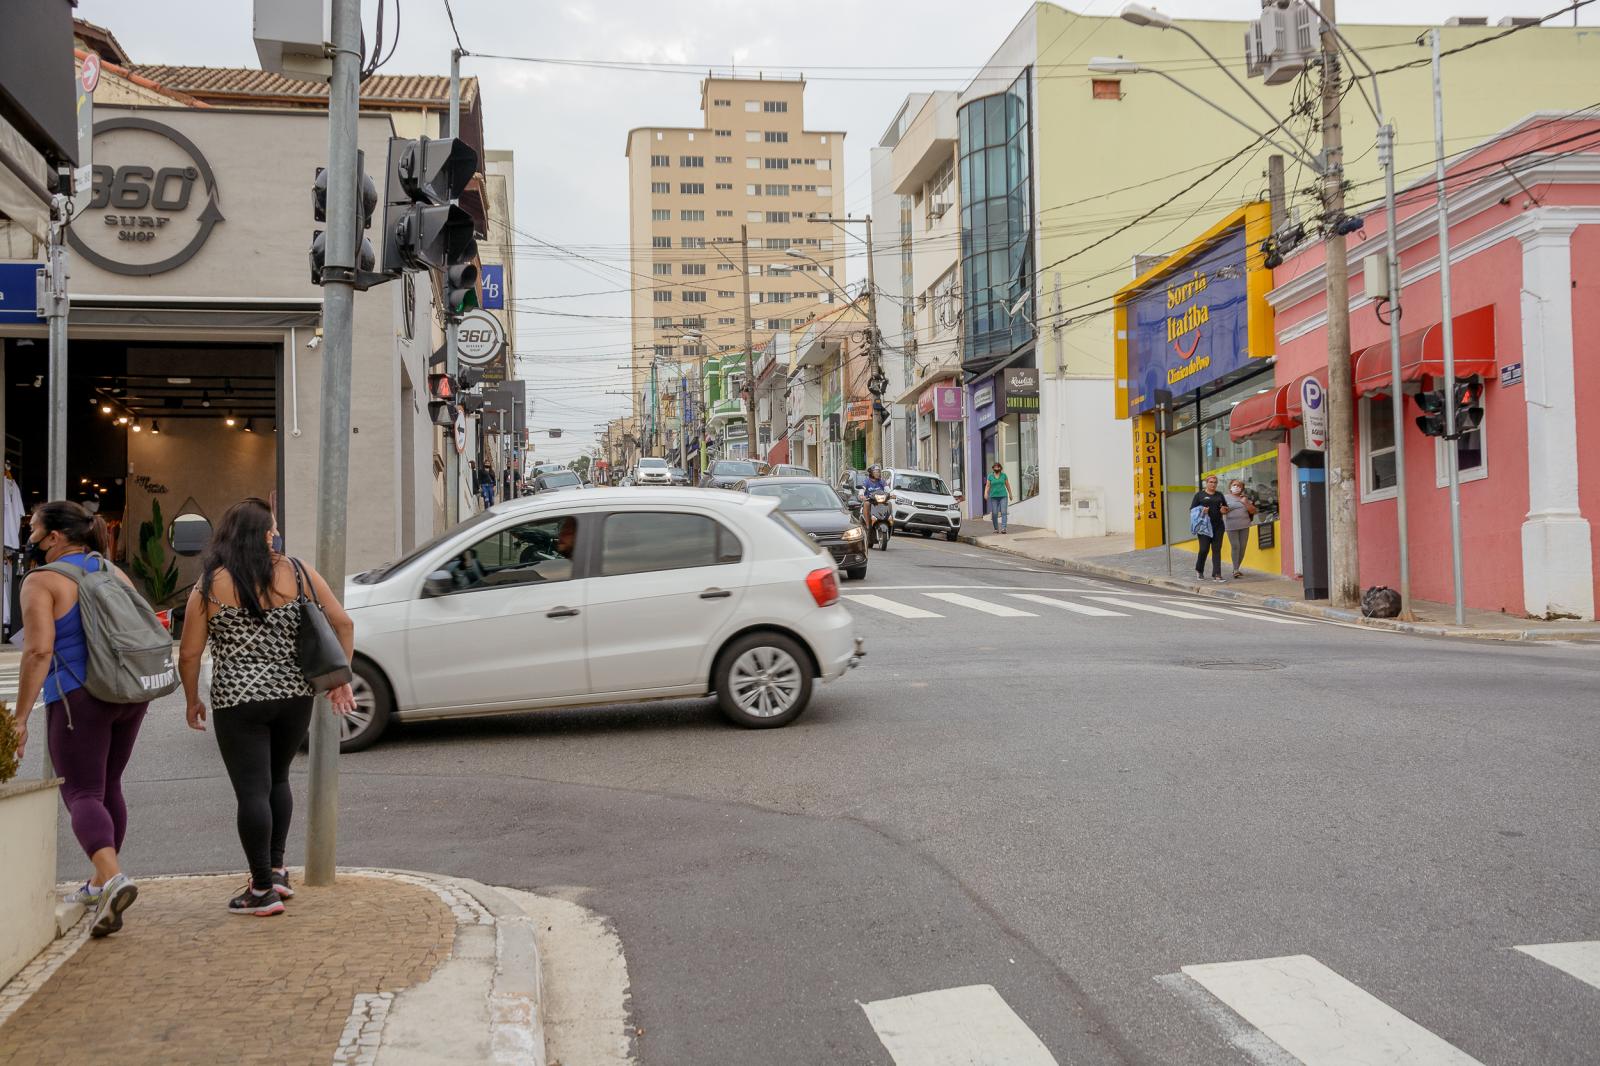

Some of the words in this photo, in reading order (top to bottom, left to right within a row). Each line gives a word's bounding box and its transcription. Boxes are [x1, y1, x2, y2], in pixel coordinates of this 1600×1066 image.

[104, 214, 170, 228] SURF
[118, 230, 156, 242] SHOP
[1167, 271, 1208, 309] Sorria
[1167, 304, 1210, 343] Itatiba
[1145, 432, 1157, 519] Dentista
